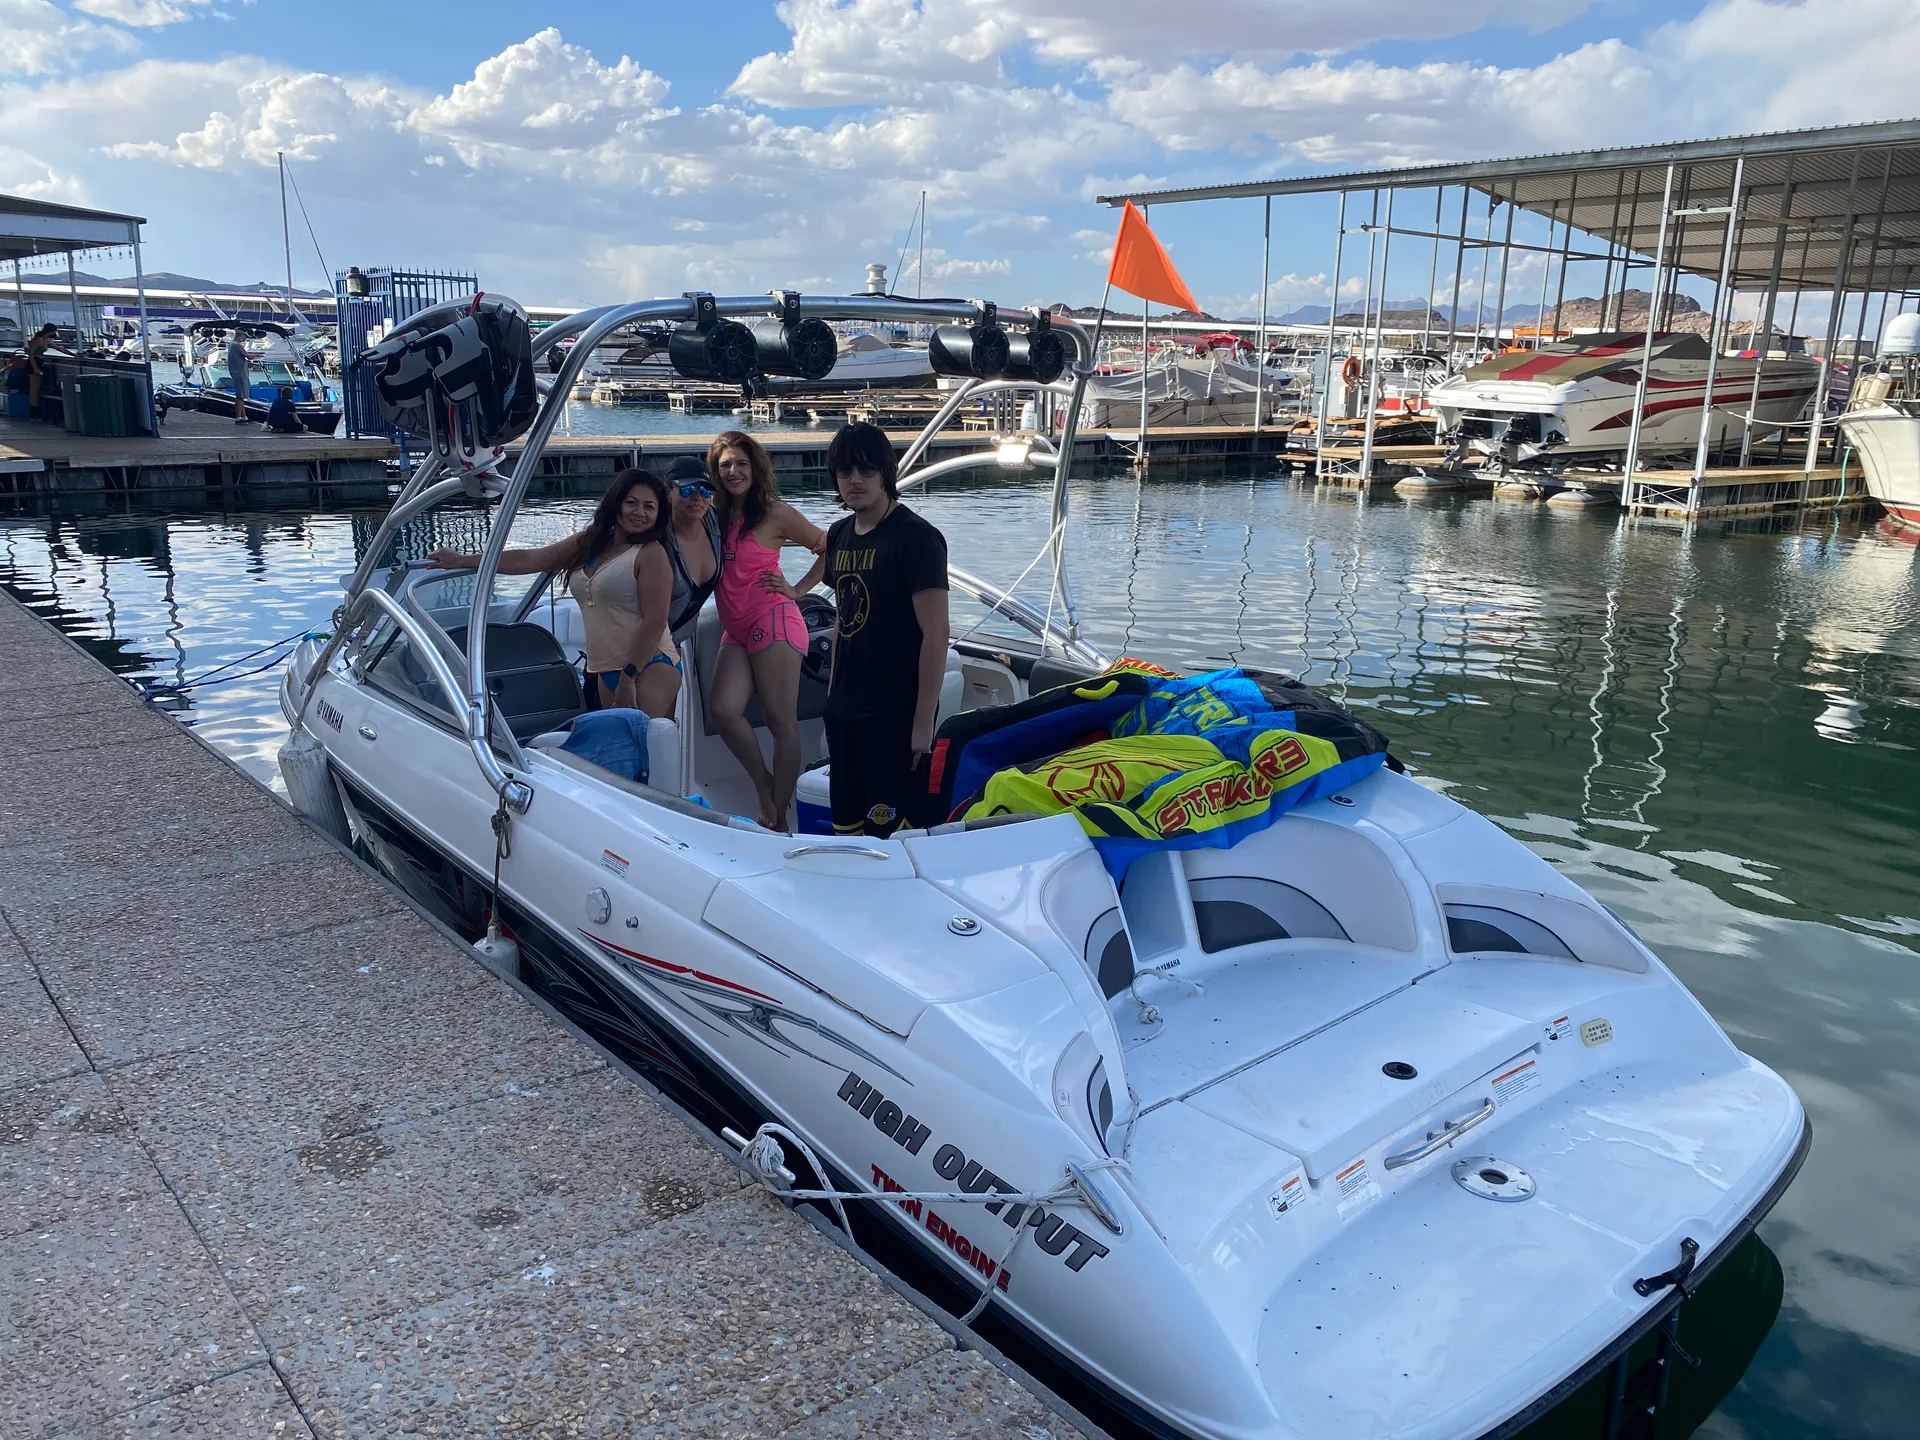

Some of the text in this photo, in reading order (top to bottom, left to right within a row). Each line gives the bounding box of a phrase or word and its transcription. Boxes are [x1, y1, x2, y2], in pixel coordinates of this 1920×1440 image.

[321, 701, 344, 734] YAMAHA
[837, 1071, 1110, 1273] HIGH OUTPUT
[871, 1163, 1012, 1293] TWIN ENGINE
